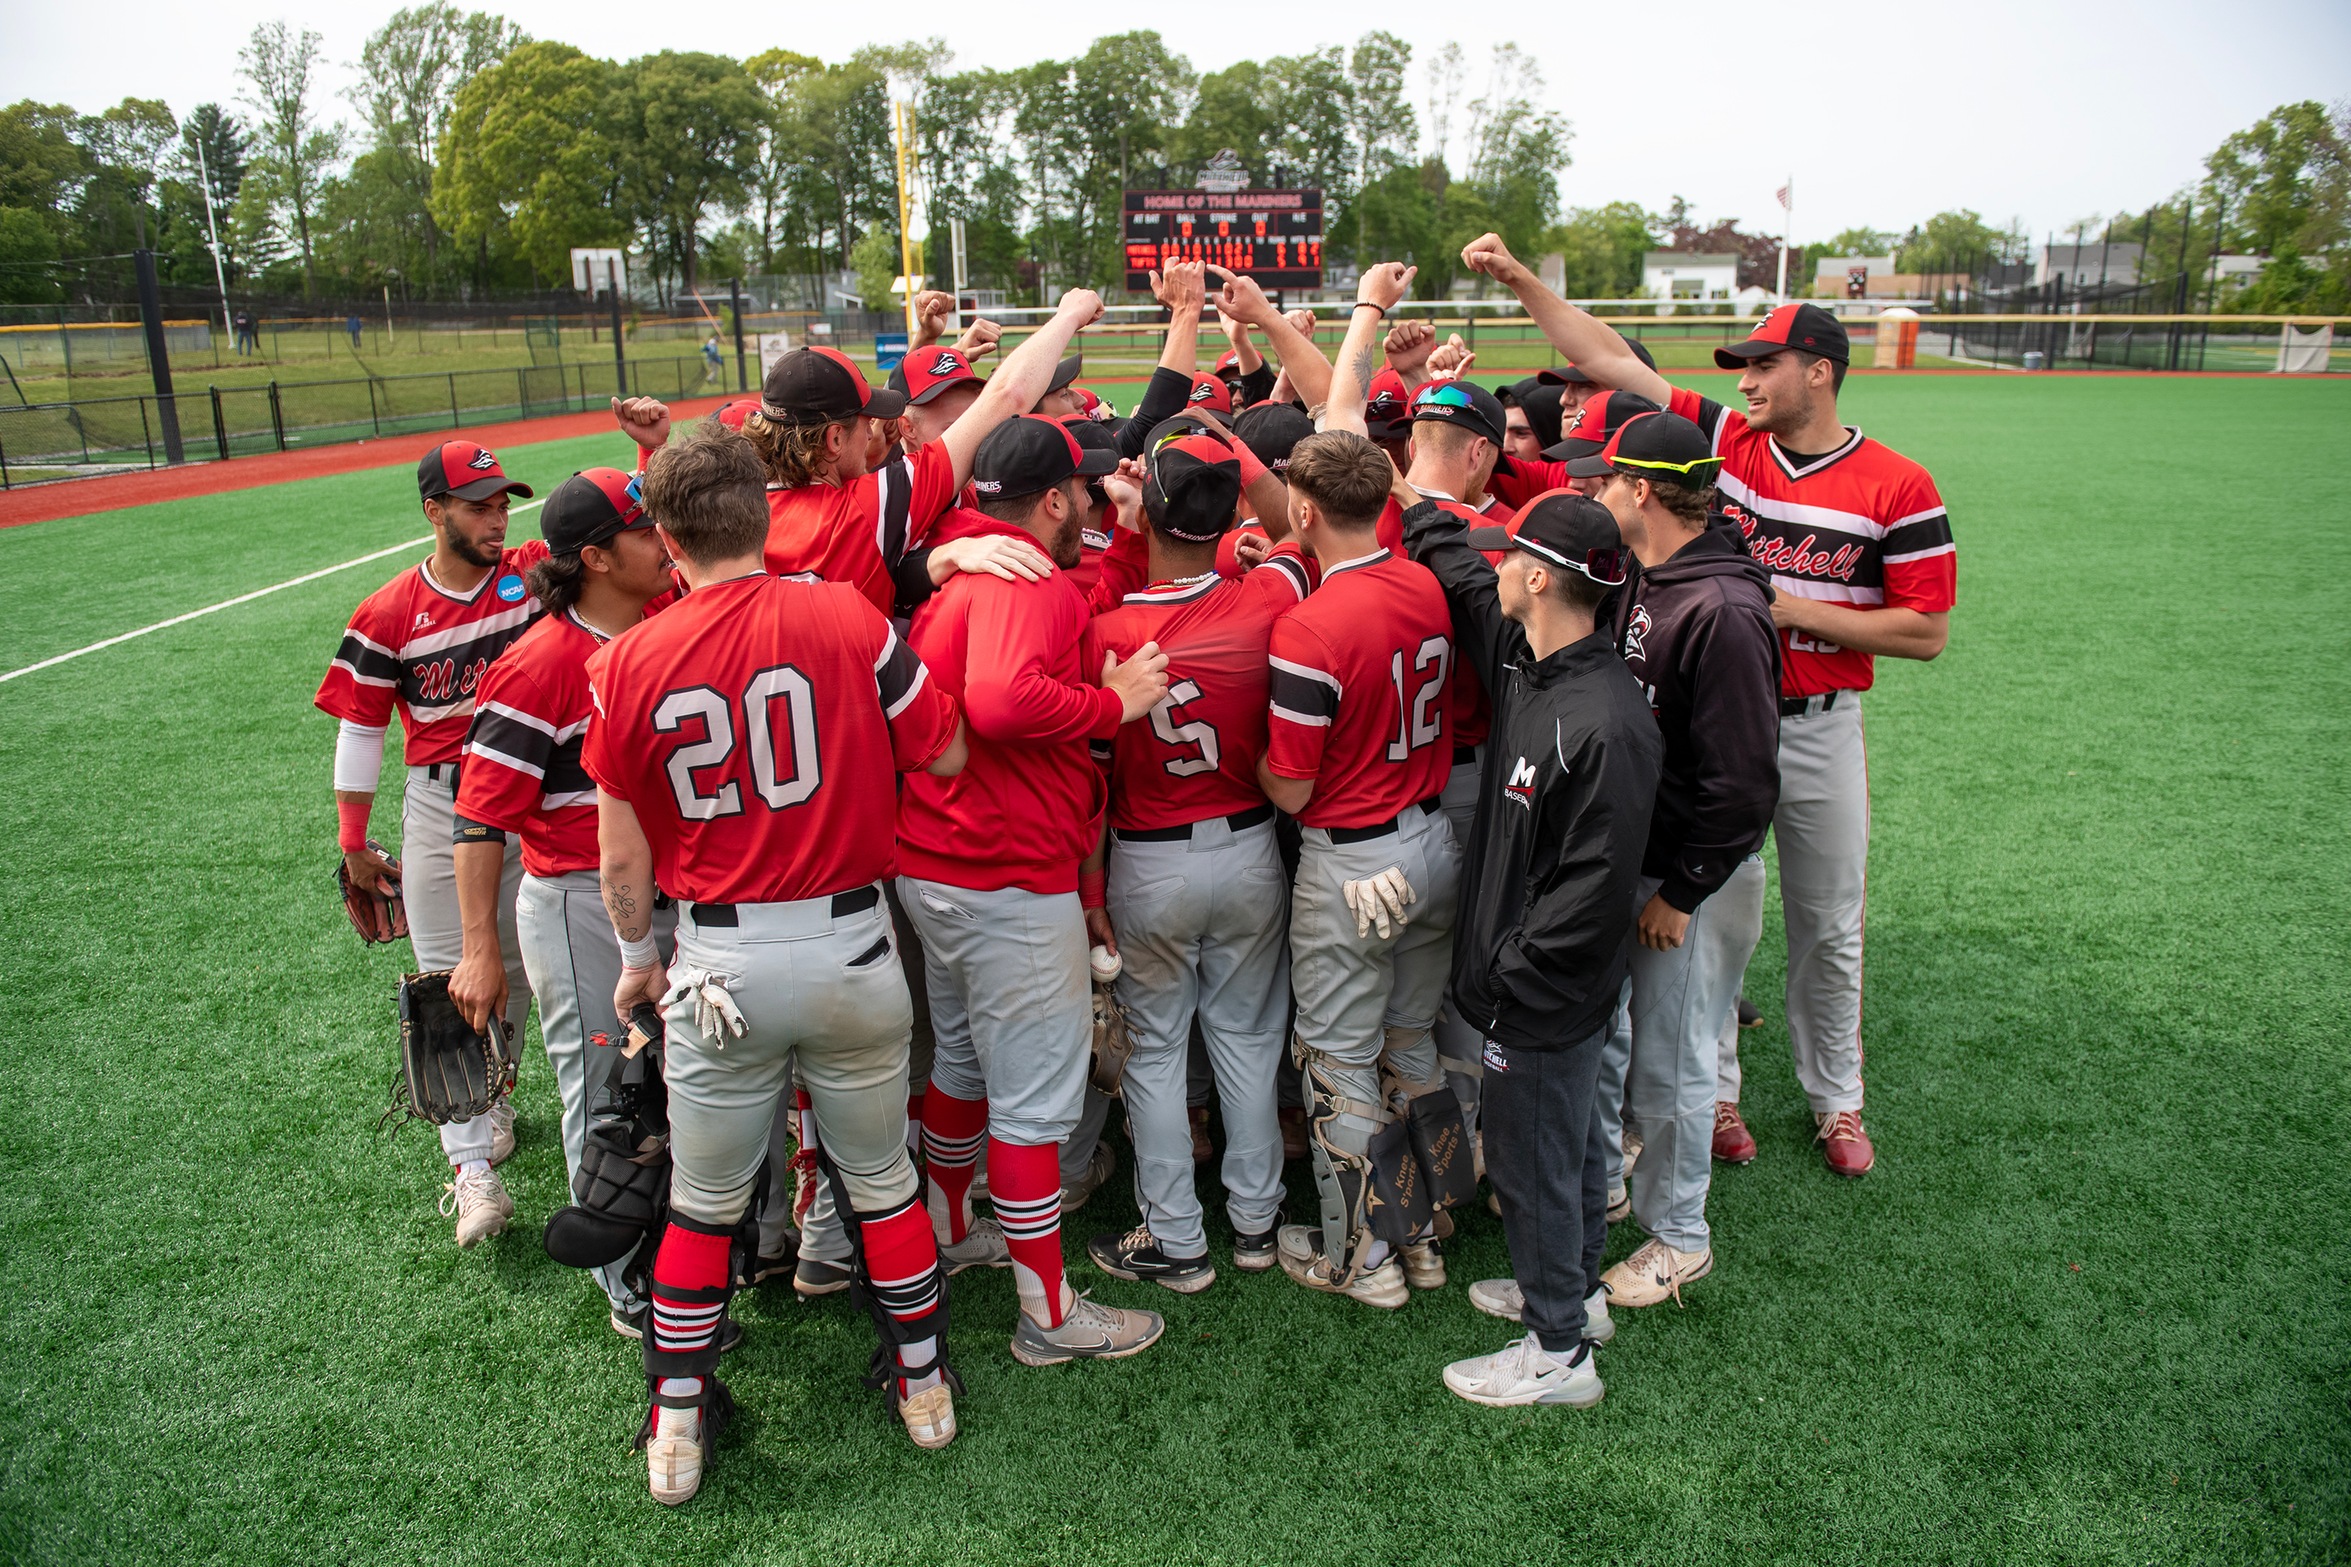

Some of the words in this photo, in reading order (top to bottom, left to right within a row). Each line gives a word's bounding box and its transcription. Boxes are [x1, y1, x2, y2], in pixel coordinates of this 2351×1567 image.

[1144, 195, 1185, 209] HOME
[1186, 195, 1205, 208] OF
[1206, 194, 1233, 208] THE
[1234, 194, 1303, 208] MARINERS
[1176, 213, 1197, 224] BALL
[1209, 213, 1238, 224] STRIKE
[1251, 213, 1269, 224] OUT
[1130, 257, 1157, 268] TUFTS
[501, 585, 525, 597] NCAA
[413, 657, 487, 700] Mit
[1386, 632, 1450, 763] 12
[650, 662, 823, 823] 20
[1149, 677, 1220, 778] 5
[1508, 756, 1537, 787] M
[1504, 788, 1530, 811] BASEBA
[1428, 1127, 1451, 1158] Knee
[1432, 1136, 1459, 1177] S'ports
[1395, 1155, 1409, 1189] Knee
[1400, 1162, 1417, 1208] S'ports
